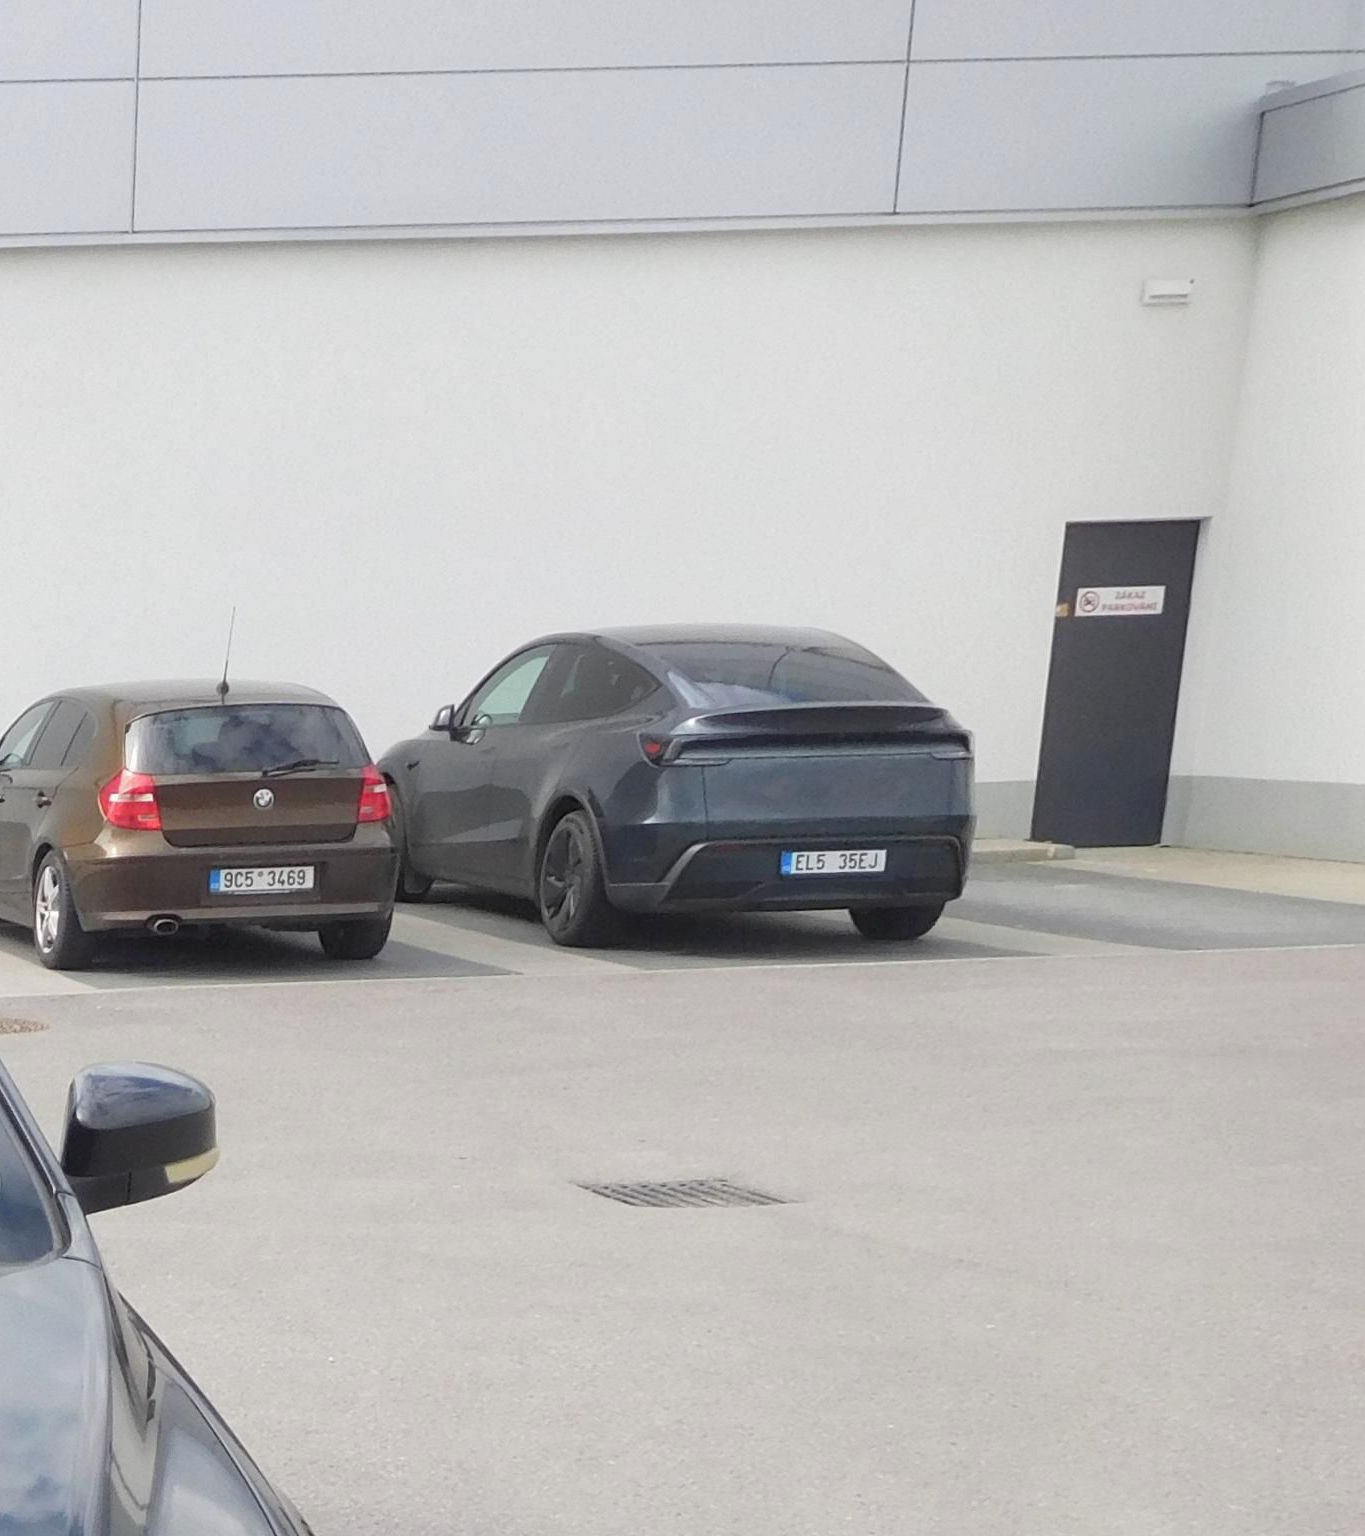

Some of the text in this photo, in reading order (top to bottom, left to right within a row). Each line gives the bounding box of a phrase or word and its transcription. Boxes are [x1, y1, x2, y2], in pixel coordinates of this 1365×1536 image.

[795, 853, 878, 871] EL5 35EJ
[224, 869, 306, 888] 9C5 3469
